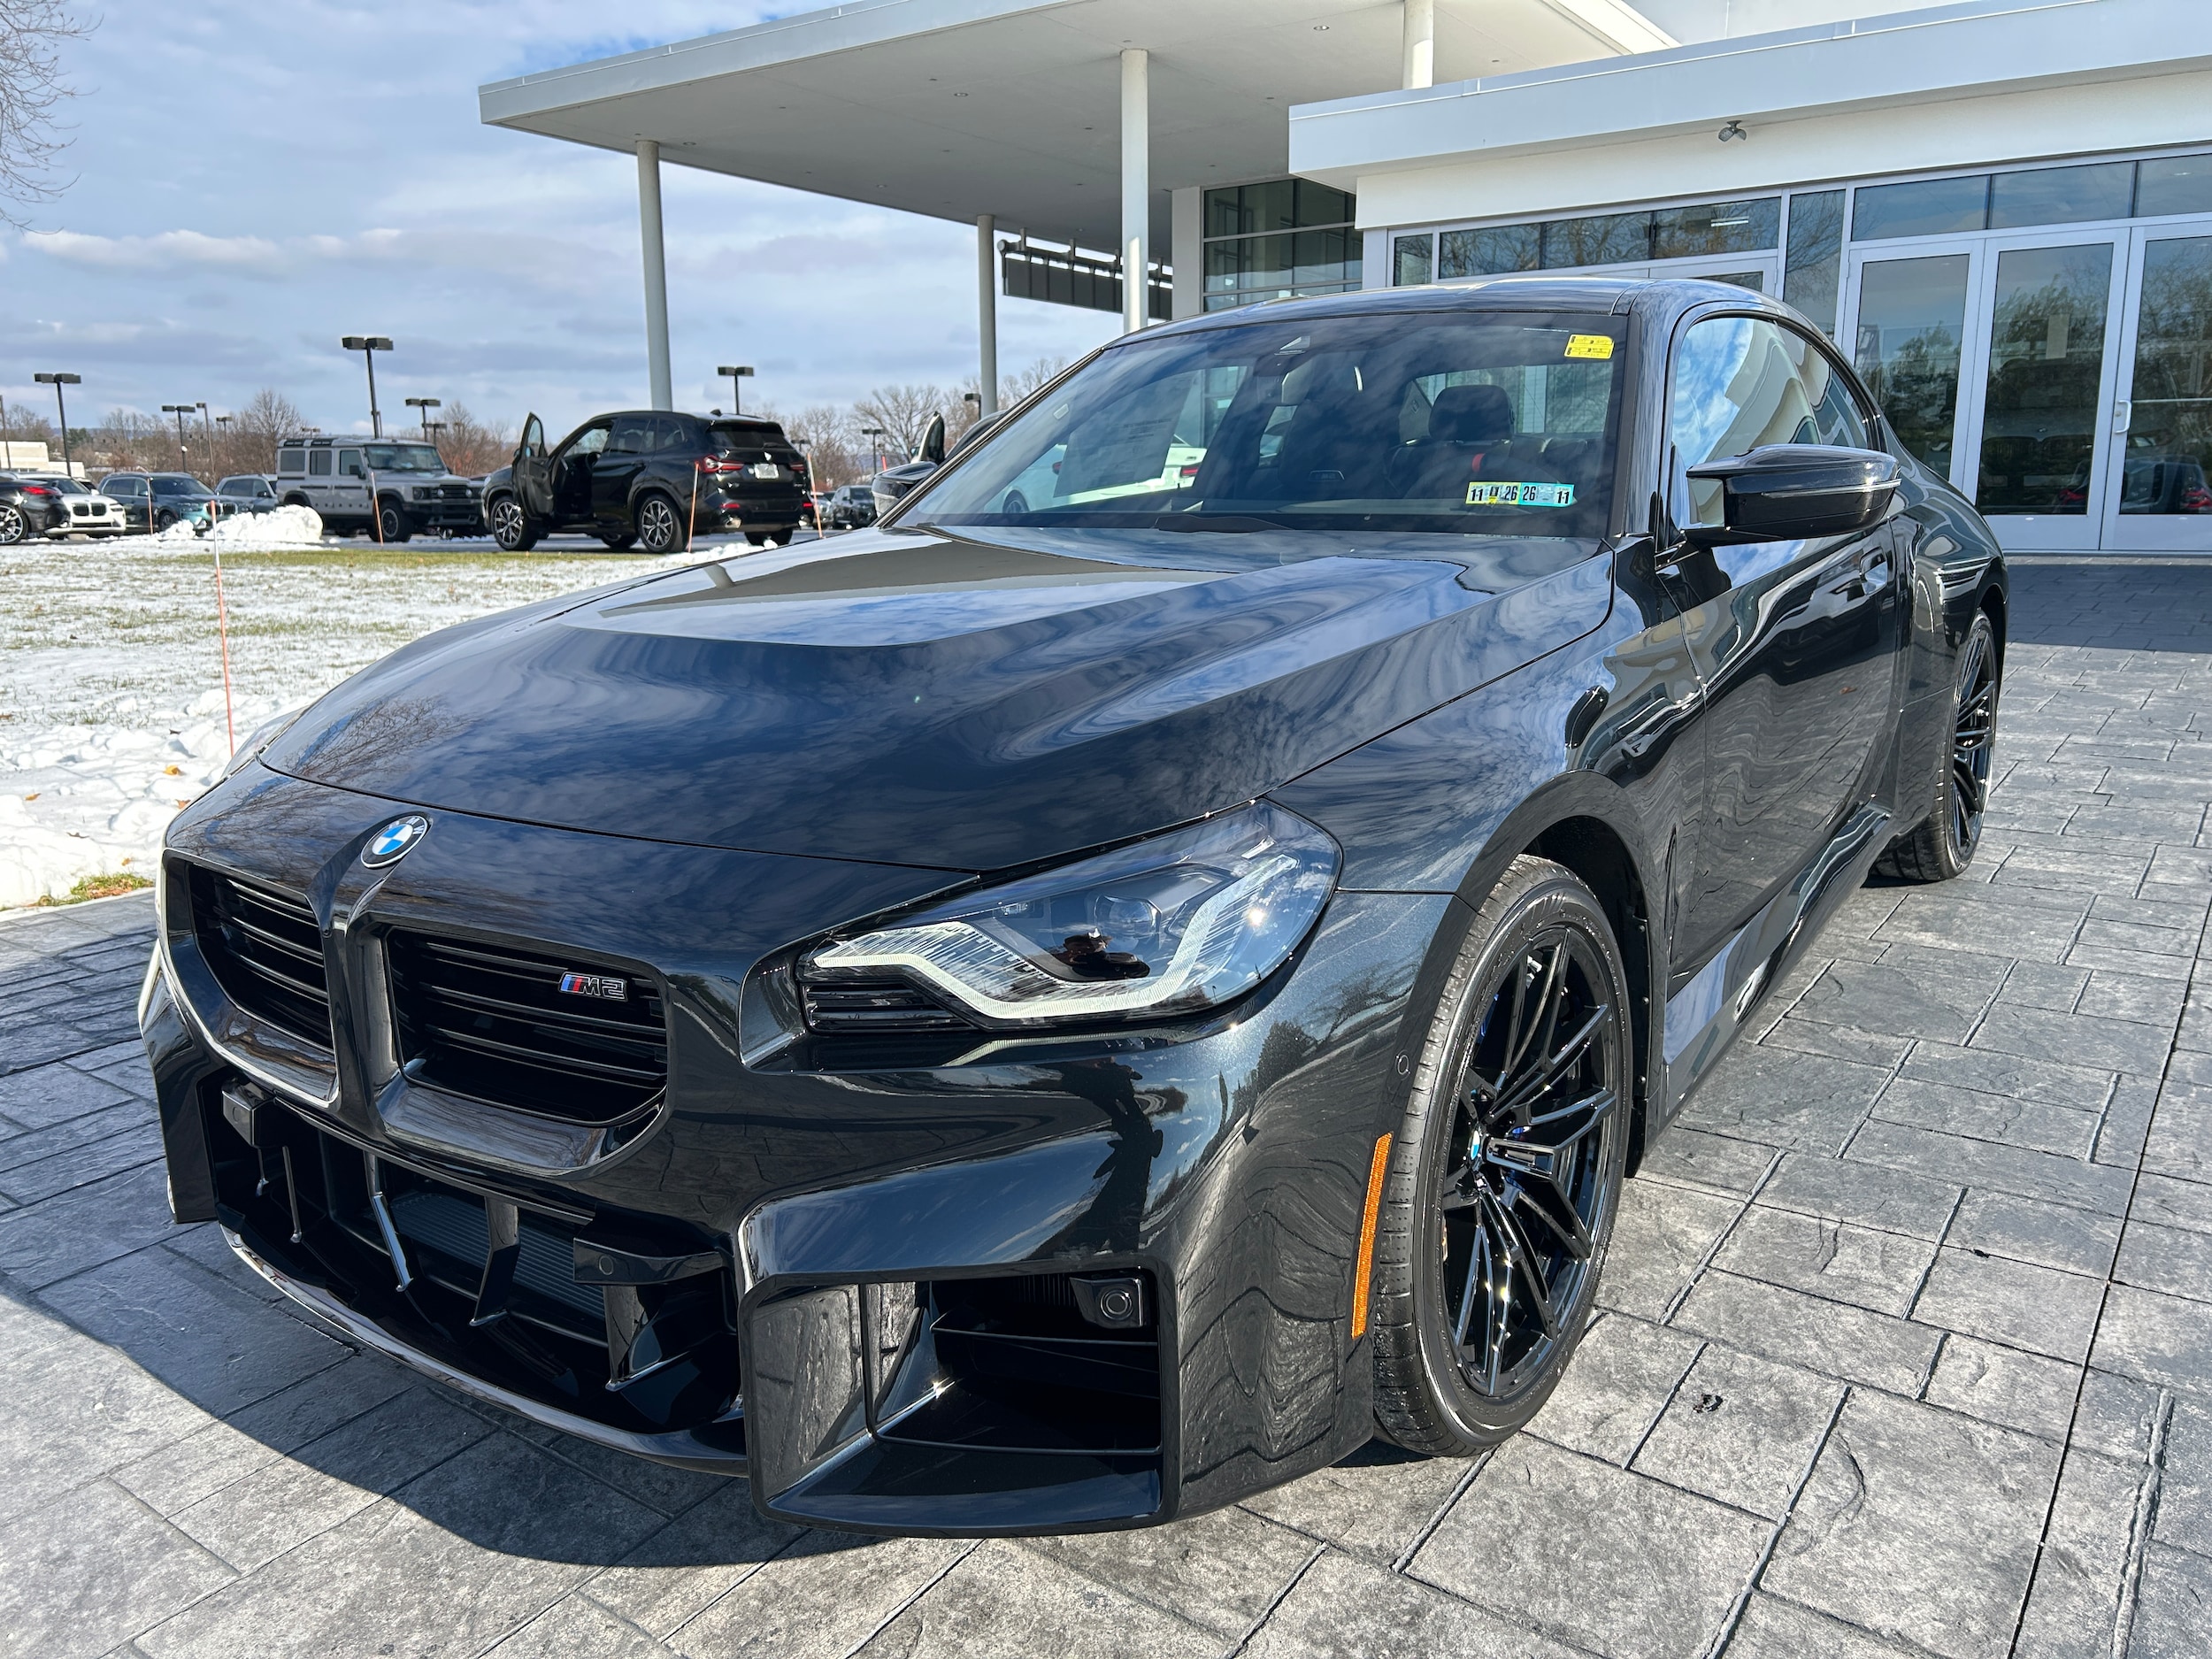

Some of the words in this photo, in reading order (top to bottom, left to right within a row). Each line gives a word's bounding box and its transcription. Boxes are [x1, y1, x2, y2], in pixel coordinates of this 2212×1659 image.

[1471, 488, 1484, 502] 11
[1505, 485, 1518, 501] 26
[1522, 486, 1537, 501] 26
[1556, 490, 1571, 504] 11
[572, 974, 625, 1000] M2
